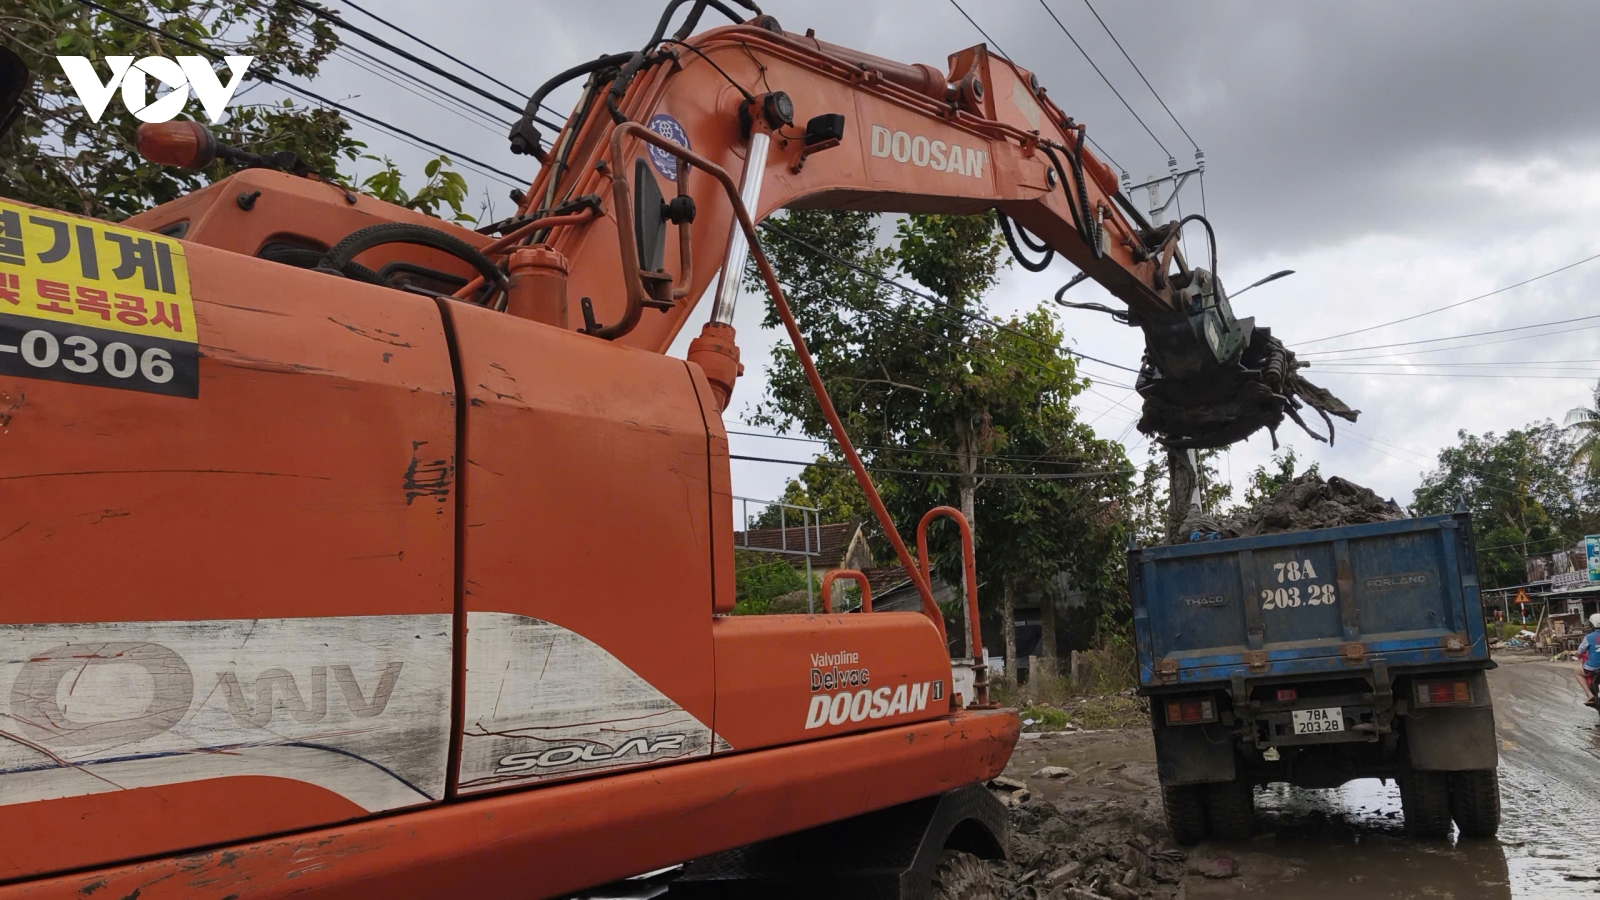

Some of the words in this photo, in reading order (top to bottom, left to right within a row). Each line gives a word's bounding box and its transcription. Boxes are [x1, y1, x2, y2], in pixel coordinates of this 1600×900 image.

[870, 124, 983, 178] DOOSAN
[1274, 559, 1318, 583] 78A
[1367, 575, 1426, 588] FORLAND
[1185, 595, 1224, 606] THACO
[1261, 583, 1336, 610] 203.28
[810, 650, 859, 667] Valvoline
[810, 665, 870, 692] Delvac
[805, 681, 930, 730] DOOSAN
[1306, 709, 1328, 721] 78A
[1299, 720, 1339, 732] 203.28
[494, 733, 687, 775] SOLAR
